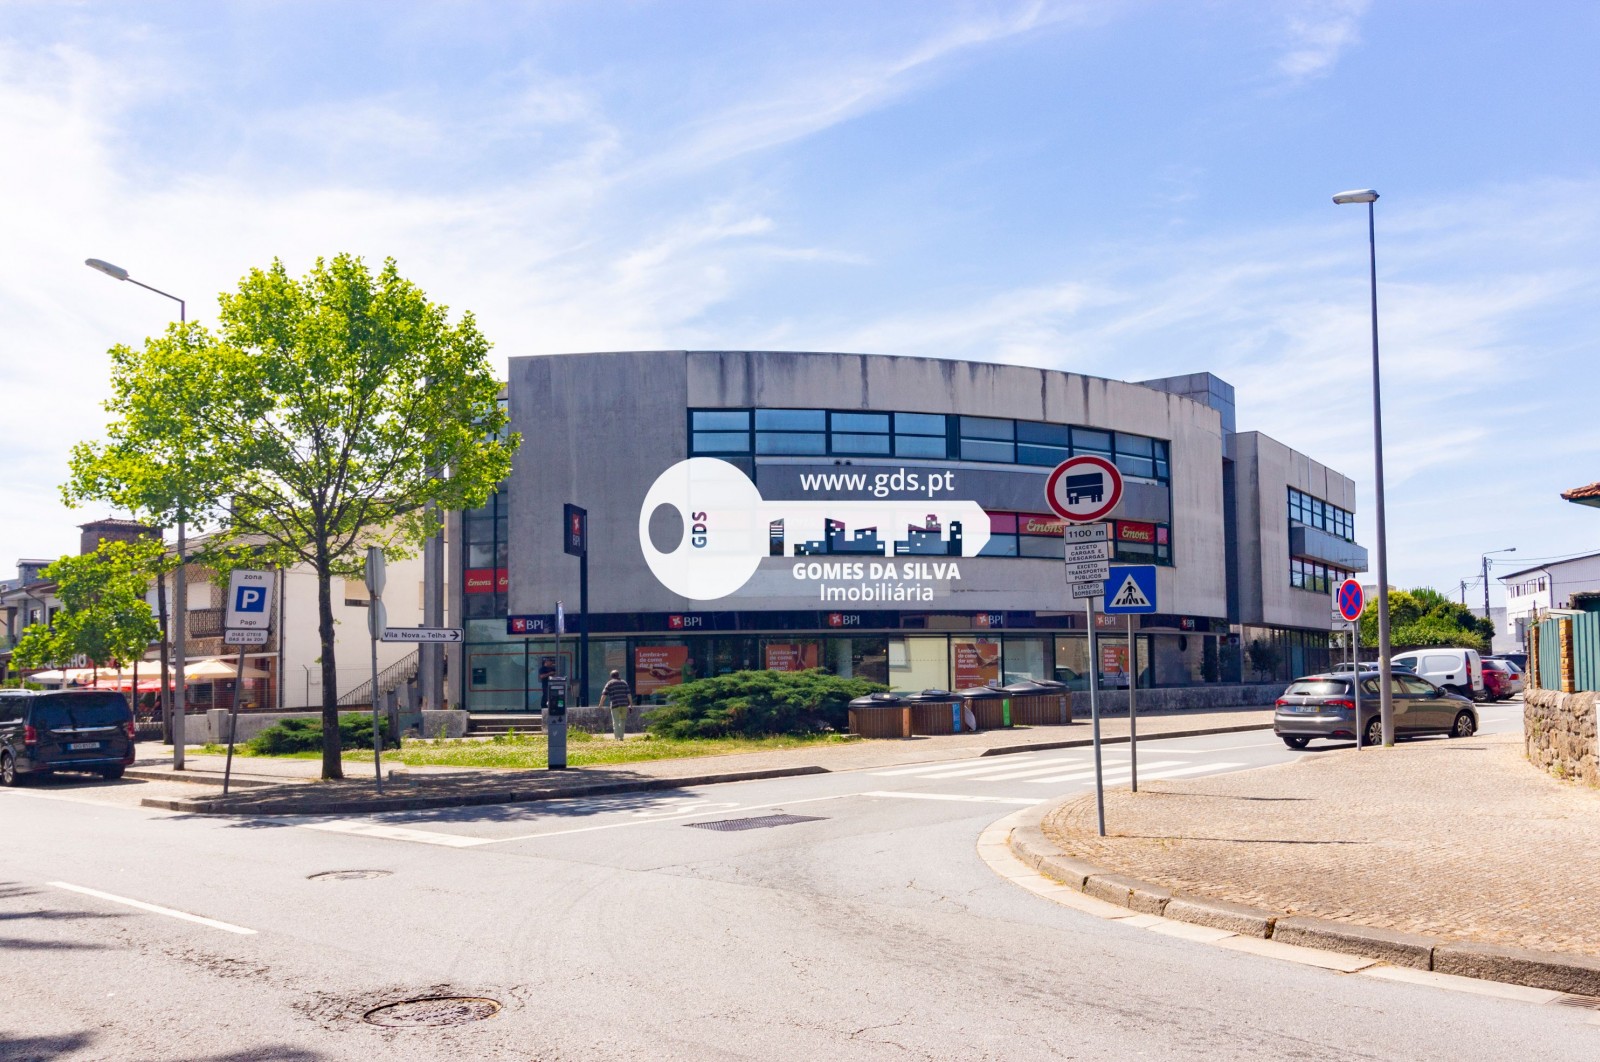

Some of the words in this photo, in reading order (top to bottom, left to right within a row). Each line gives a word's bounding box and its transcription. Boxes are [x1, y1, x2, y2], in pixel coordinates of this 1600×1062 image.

[1027, 519, 1063, 533] Emons
[1069, 530, 1092, 538] 1100
[1122, 526, 1149, 540] Emons
[526, 619, 544, 630] BPI
[683, 616, 702, 627] BPI
[842, 614, 860, 625] BPI
[988, 614, 1003, 625] BPI
[1104, 616, 1116, 626] BPI
